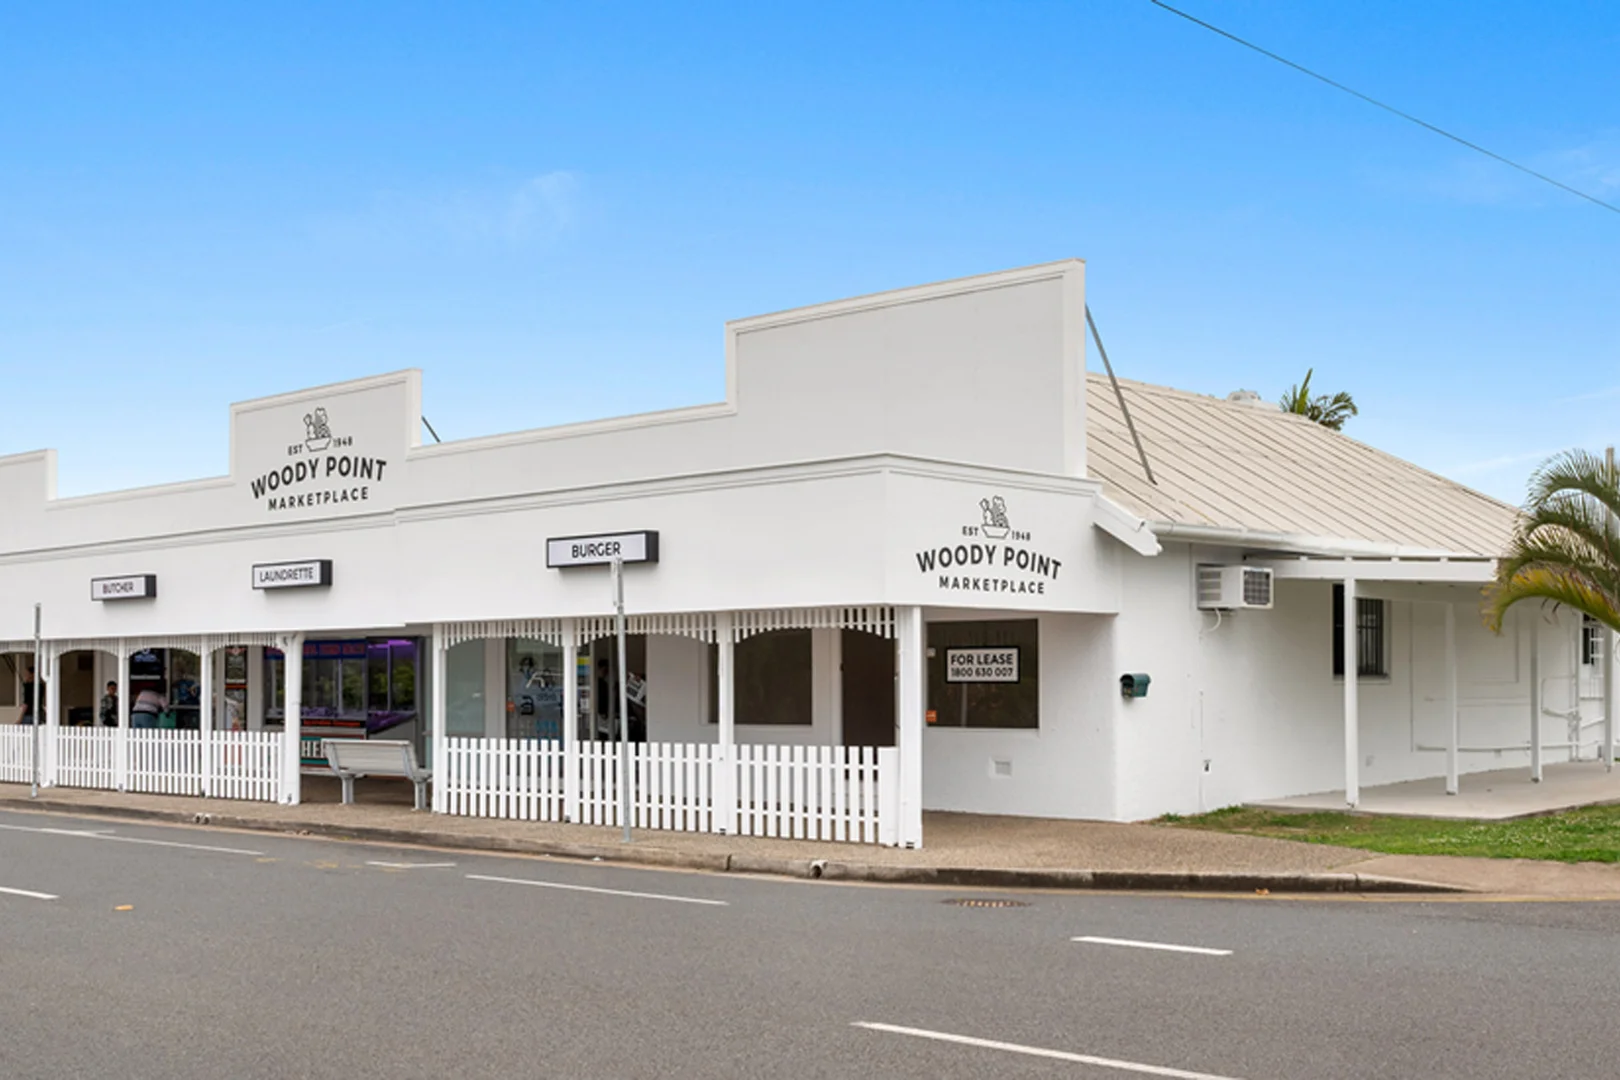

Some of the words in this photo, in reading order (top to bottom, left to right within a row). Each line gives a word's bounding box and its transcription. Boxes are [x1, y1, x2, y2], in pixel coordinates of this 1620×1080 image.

[288, 444, 303, 456] EST
[332, 436, 353, 448] 1948
[251, 457, 320, 500] WOODY
[326, 455, 387, 482] POINT
[268, 486, 369, 511] MARKETPLACE
[962, 525, 979, 537] EST
[1011, 530, 1031, 542] 1948
[571, 541, 621, 559] BURGER
[916, 543, 997, 573] WOODY
[1003, 546, 1063, 580] POINT
[259, 566, 314, 583] LAUNDRETTE
[102, 581, 134, 595] BUTCHER
[939, 575, 1045, 595] MARKETPLACE
[950, 653, 975, 666] FOR
[976, 653, 1014, 666] LEASE
[951, 667, 974, 678] 1800
[974, 667, 994, 678] 630
[994, 667, 1014, 678] 007
